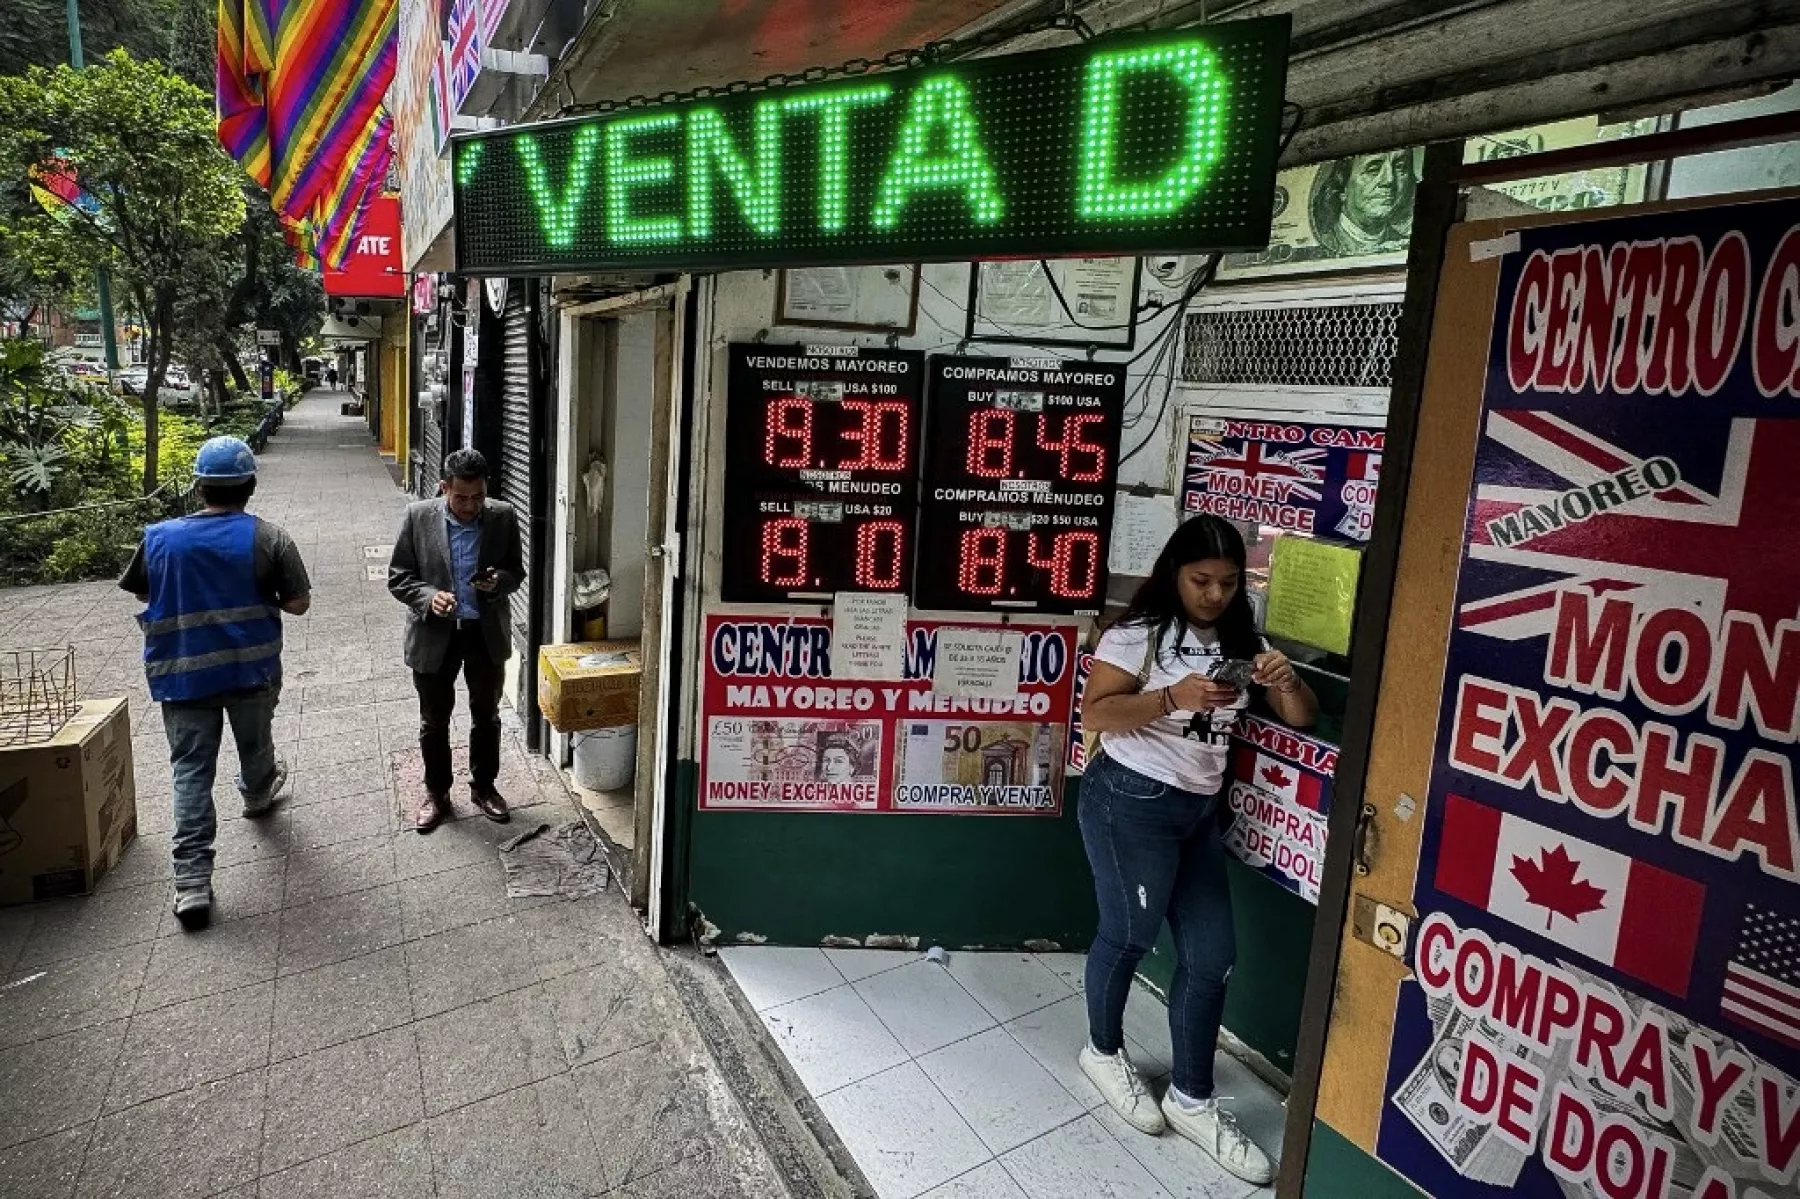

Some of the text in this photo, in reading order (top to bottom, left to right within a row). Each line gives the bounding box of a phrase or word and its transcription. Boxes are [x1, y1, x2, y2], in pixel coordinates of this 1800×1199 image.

[517, 42, 1227, 249] VENTA D
[1507, 223, 1800, 398] CENTRO C
[747, 357, 908, 373] VENDEMOS MAYOREO
[943, 367, 1115, 386] COMPRAMOS MAYOREO
[762, 380, 897, 394] SELL USA $100
[968, 392, 1101, 407] BUY $100 USA
[1223, 421, 1306, 443] NTRO
[829, 482, 901, 494] MENUDEO
[934, 489, 1104, 505] COMPRAMOS MENUDEO
[1207, 473, 1293, 502] MONEY
[759, 502, 892, 515] SELL USA $20
[1185, 491, 1315, 532] EXCHANGE
[1486, 456, 1680, 548] MAYOREO
[959, 512, 1098, 526] BUY $20 $50 USA
[713, 623, 832, 678] CENTR
[726, 685, 1051, 715] MAYOREO Y MENUDEO
[712, 720, 743, 736] £50
[943, 725, 982, 752] 50
[709, 782, 876, 802] MONEY EXCHANGE
[897, 785, 1055, 808] COMPRA Y VENTA
[1230, 786, 1315, 848] COMPRA
[1246, 827, 1272, 860] DE
[1418, 920, 1668, 1111] COMPRA
[1692, 1042, 1746, 1135] Y
[1459, 1040, 1541, 1145] DE
